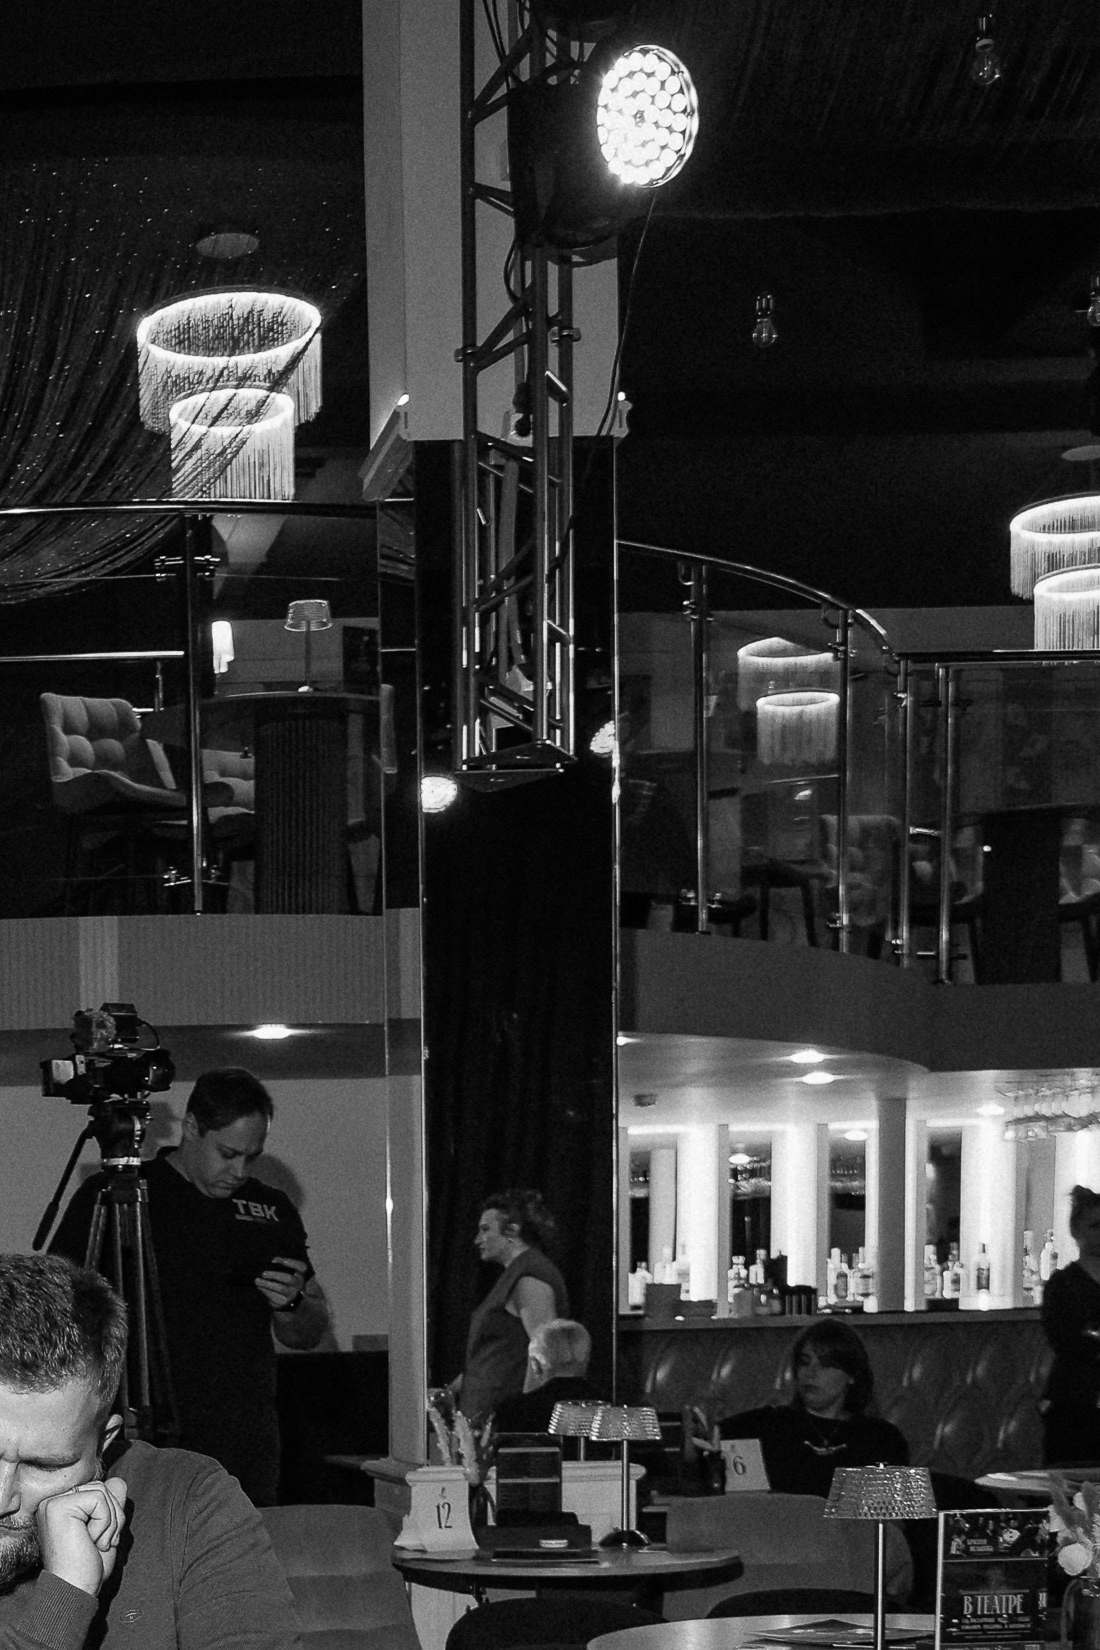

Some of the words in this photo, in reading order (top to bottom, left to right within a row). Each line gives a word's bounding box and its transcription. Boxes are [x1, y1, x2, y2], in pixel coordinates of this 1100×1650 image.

[733, 1455, 746, 1475] 6
[436, 1502, 452, 1529] 12
[963, 1596, 973, 1615] В
[975, 1594, 1024, 1614] ТЕАТРЕ
